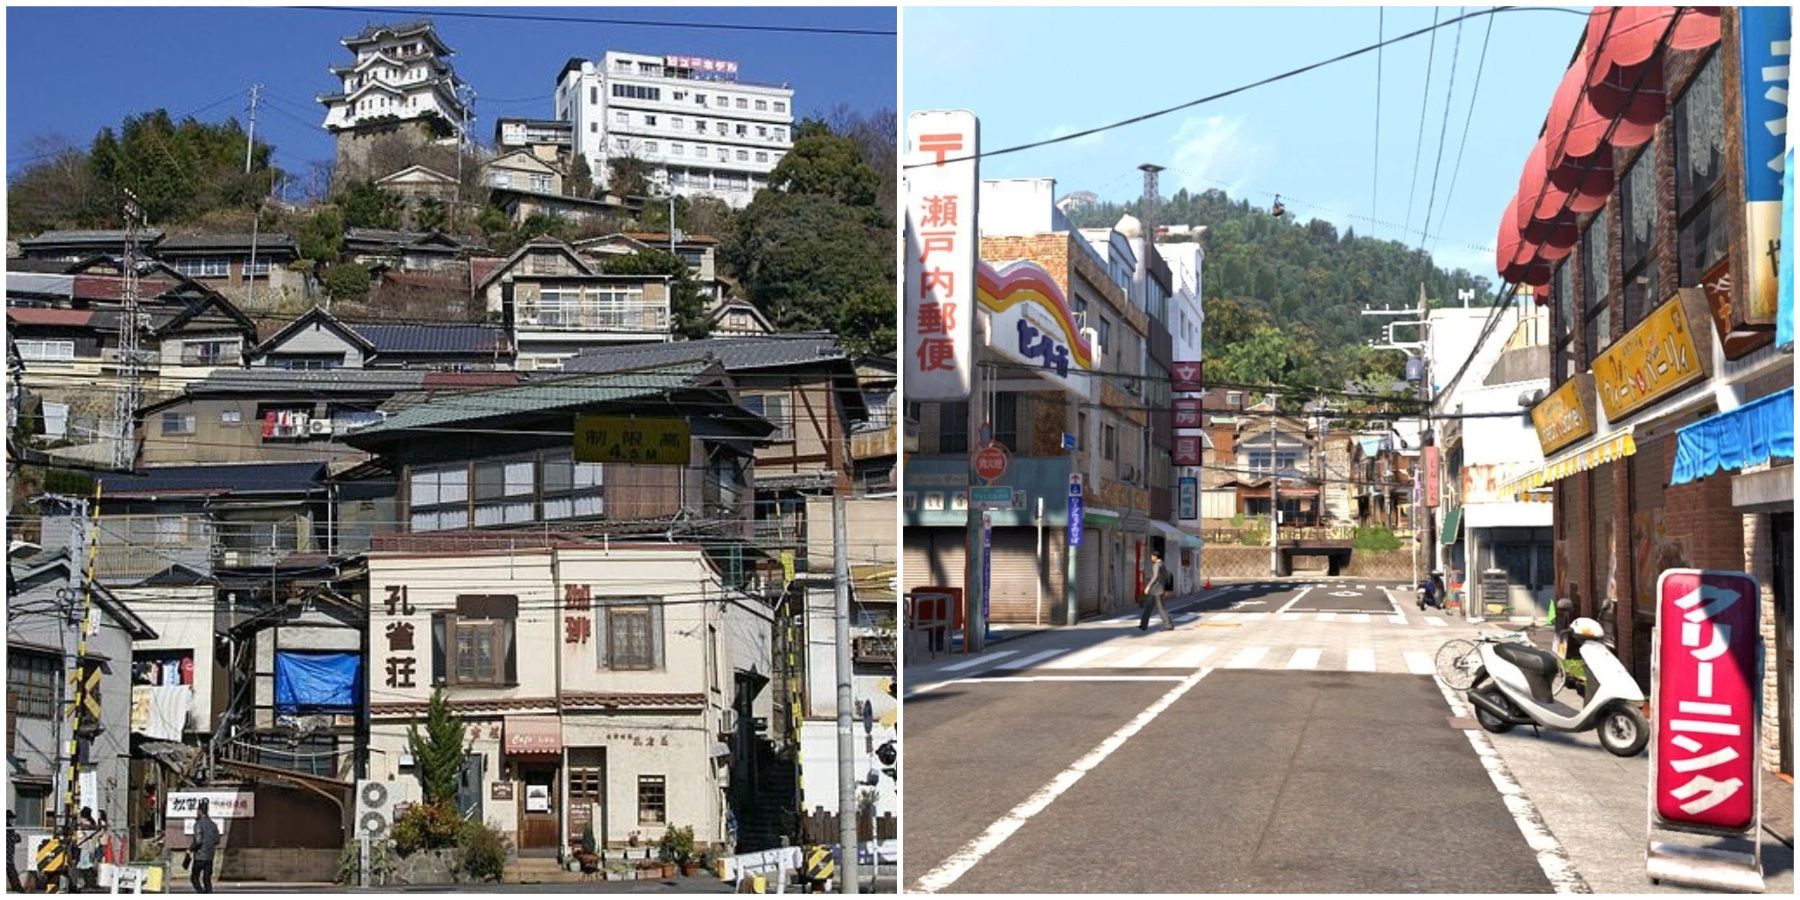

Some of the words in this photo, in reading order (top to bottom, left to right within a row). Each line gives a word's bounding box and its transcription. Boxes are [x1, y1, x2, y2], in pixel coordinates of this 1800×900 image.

[917, 195, 958, 372] 瀬戸内郵便
[384, 585, 416, 688] 孔雀荘
